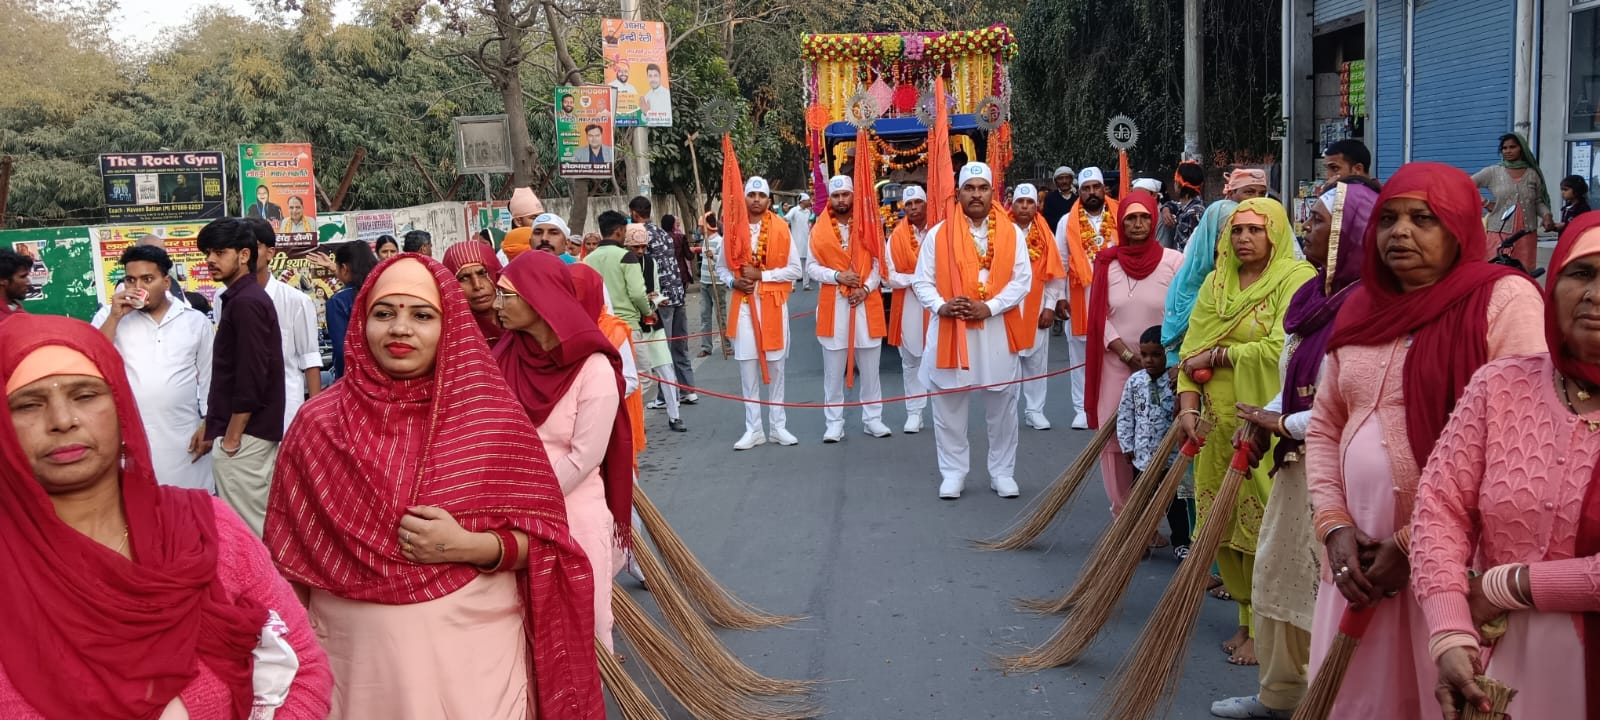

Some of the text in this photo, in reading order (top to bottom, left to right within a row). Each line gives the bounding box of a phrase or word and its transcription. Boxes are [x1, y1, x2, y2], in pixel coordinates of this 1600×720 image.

[107, 154, 218, 167] The Rock Gym
[254, 157, 298, 168] नववर्ष
